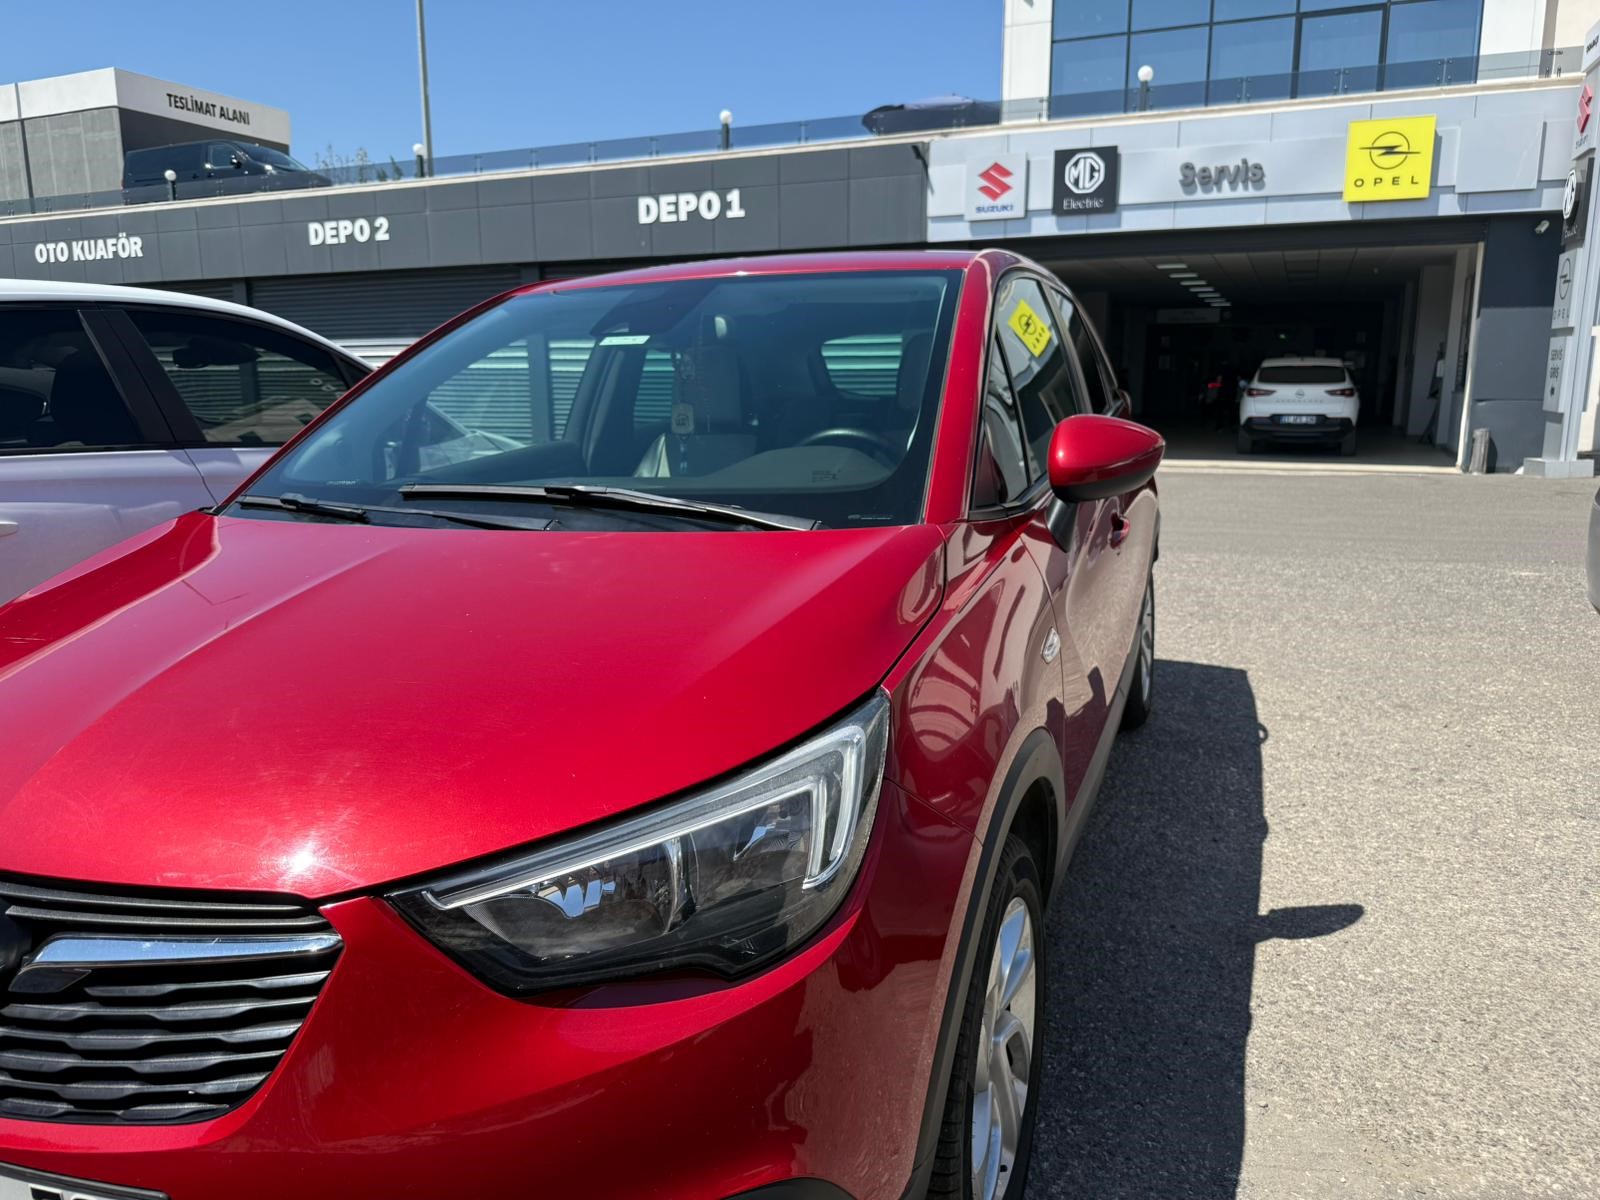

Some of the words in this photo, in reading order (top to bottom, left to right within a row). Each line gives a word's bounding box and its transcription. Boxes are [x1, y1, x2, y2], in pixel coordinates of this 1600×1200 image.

[166, 93, 216, 117] TESLİMAT
[219, 106, 250, 125] ALANI
[1068, 155, 1103, 191] MG
[1179, 158, 1265, 188] Servis
[1354, 175, 1419, 188] OPEL
[637, 190, 721, 224] DEPO
[726, 188, 745, 218] 1
[975, 204, 1014, 214] SUZUKI
[1063, 198, 1104, 210] Electric
[308, 218, 370, 246] DEPO
[374, 216, 390, 241] 2
[34, 241, 69, 264] OTO
[72, 232, 143, 262] KUAFÖR
